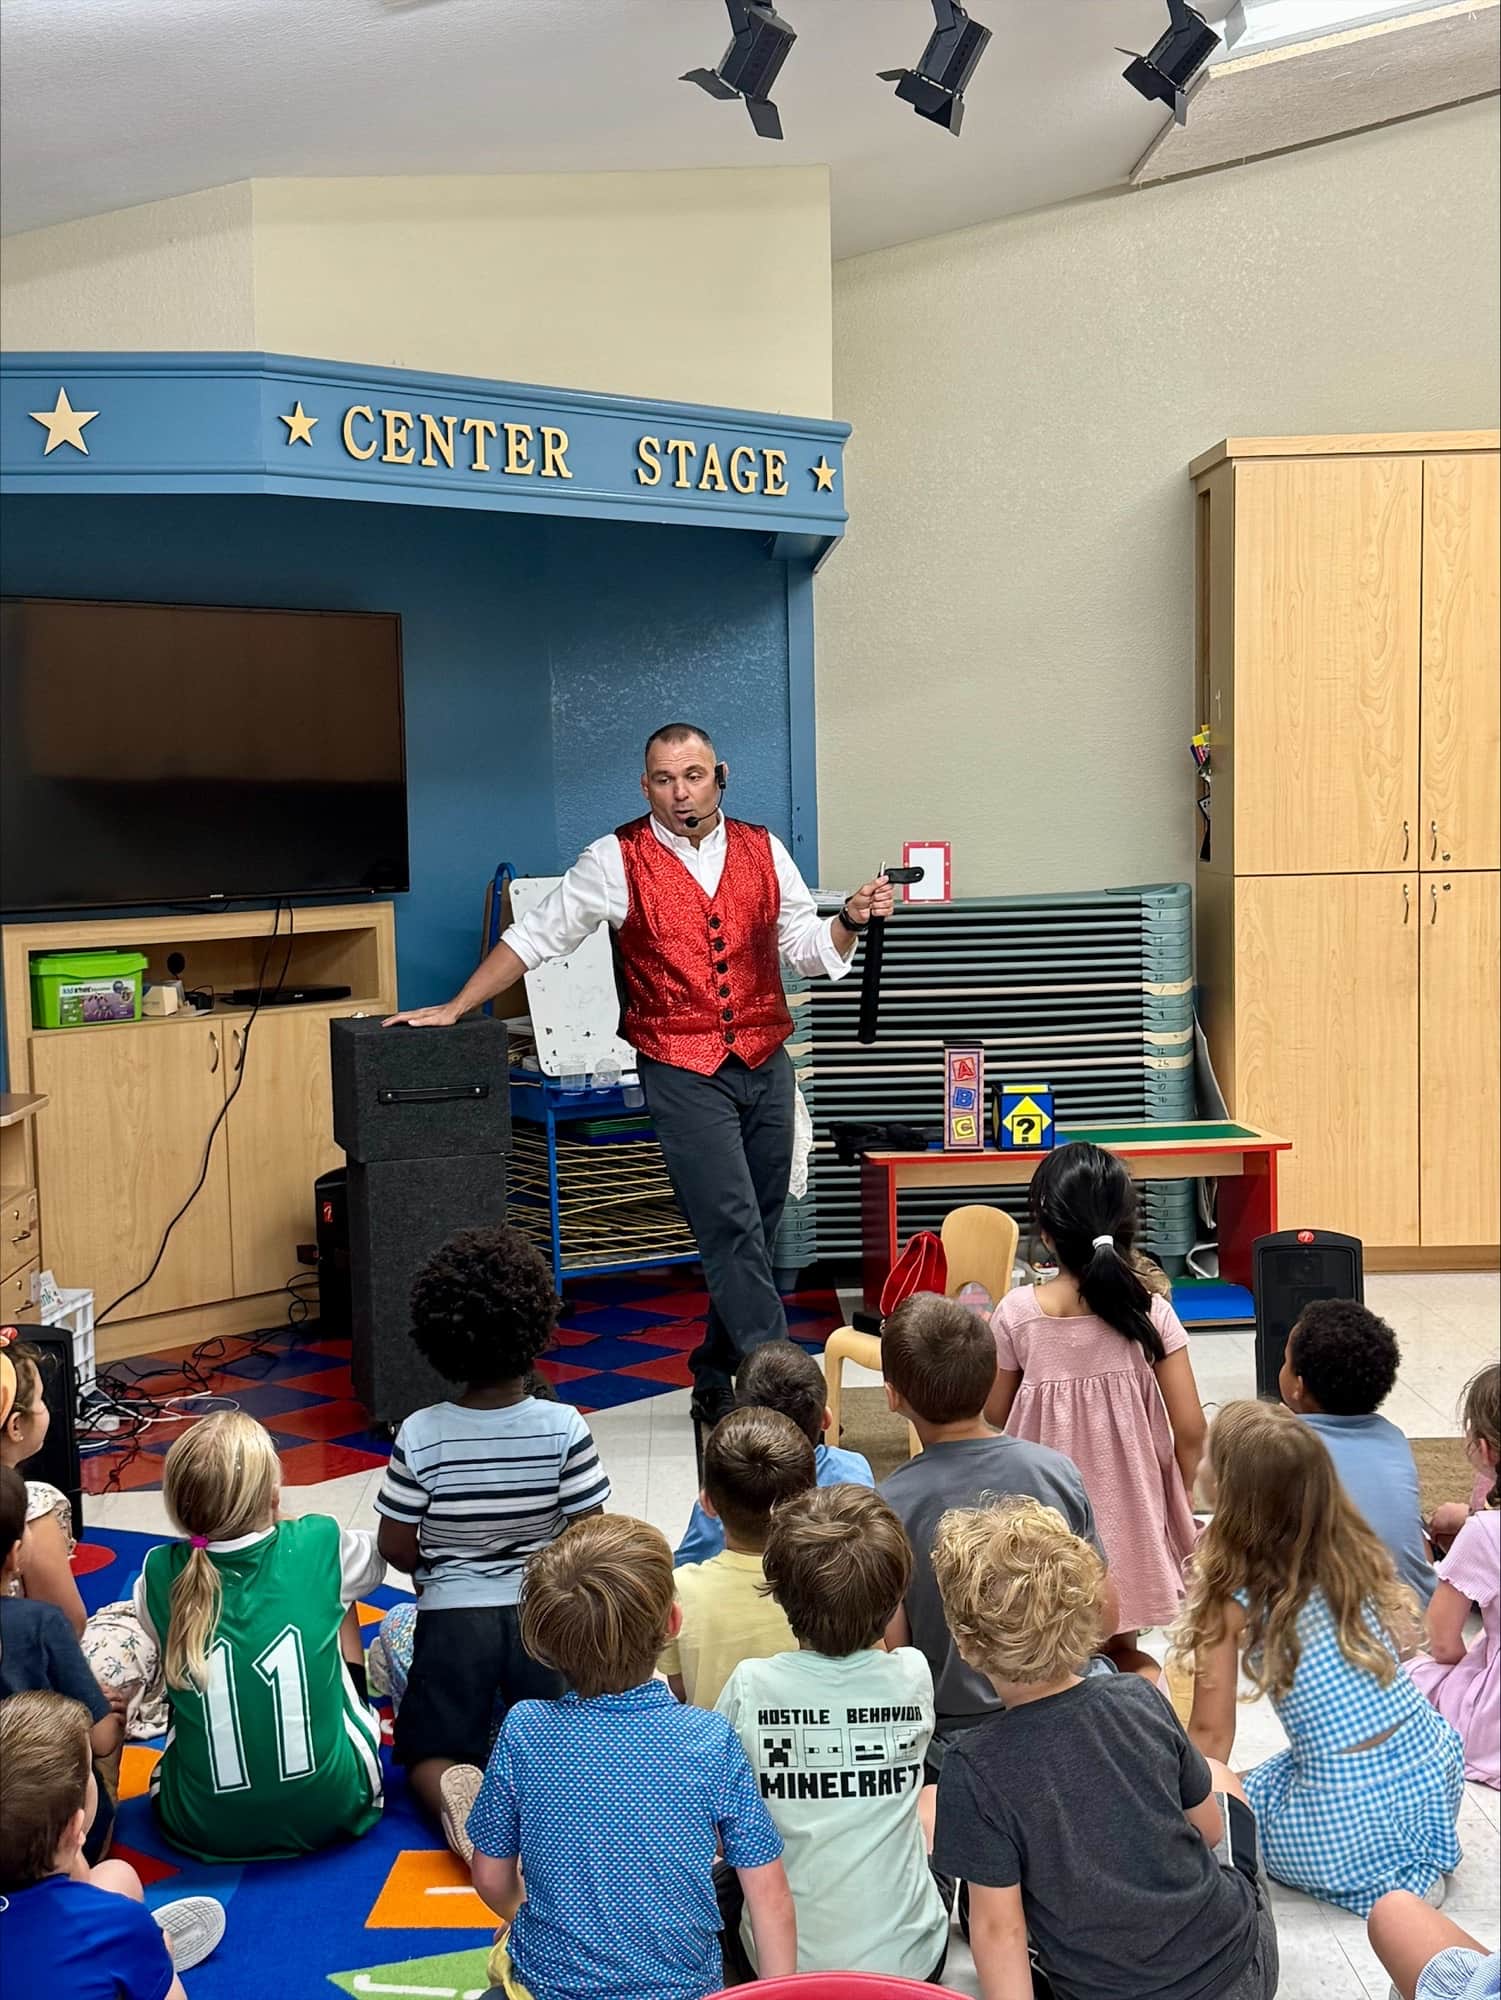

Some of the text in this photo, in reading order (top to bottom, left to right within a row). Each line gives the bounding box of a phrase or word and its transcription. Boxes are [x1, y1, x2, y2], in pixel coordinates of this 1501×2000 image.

[343, 405, 789, 497] CENTER STAGE
[185, 1624, 316, 1794] 11
[758, 1706, 923, 1725] HOSTILE BEHAVIOR
[760, 1764, 921, 1799] MINECRAFT
